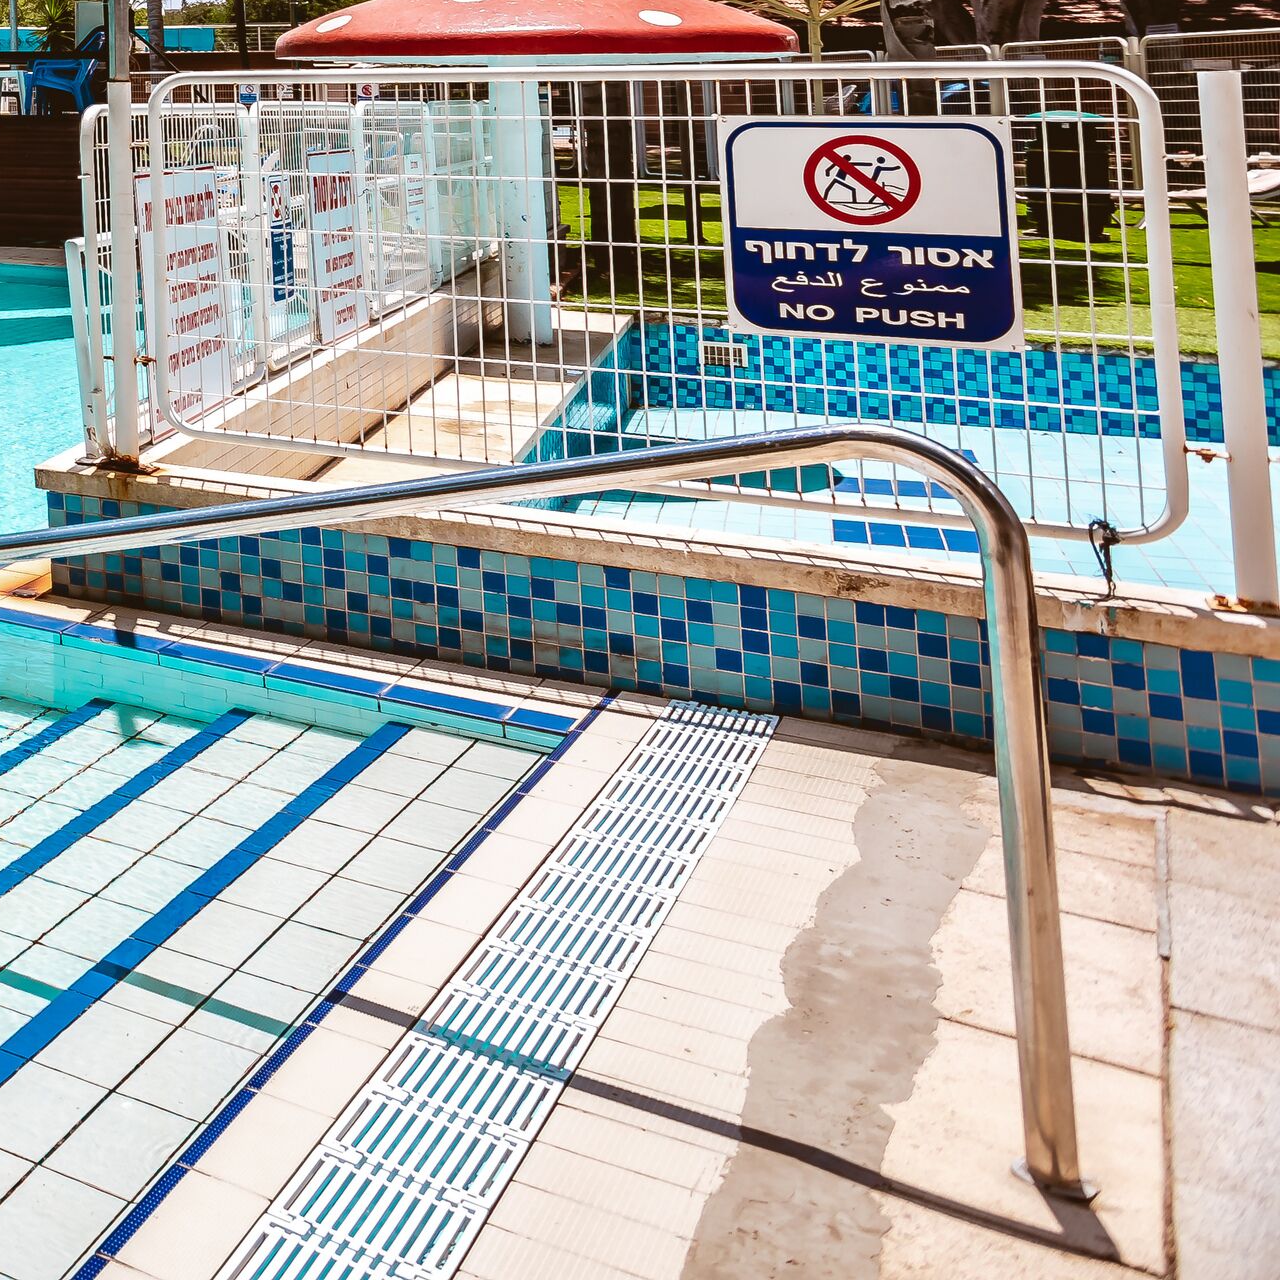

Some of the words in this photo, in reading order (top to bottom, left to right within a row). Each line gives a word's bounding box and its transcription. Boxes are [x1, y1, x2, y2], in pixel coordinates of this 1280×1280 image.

[745, 239, 868, 264] לדחוף
[888, 245, 995, 268] אסור
[771, 271, 843, 292] الدفع
[779, 303, 835, 321] NO
[856, 307, 965, 329] PUSH
